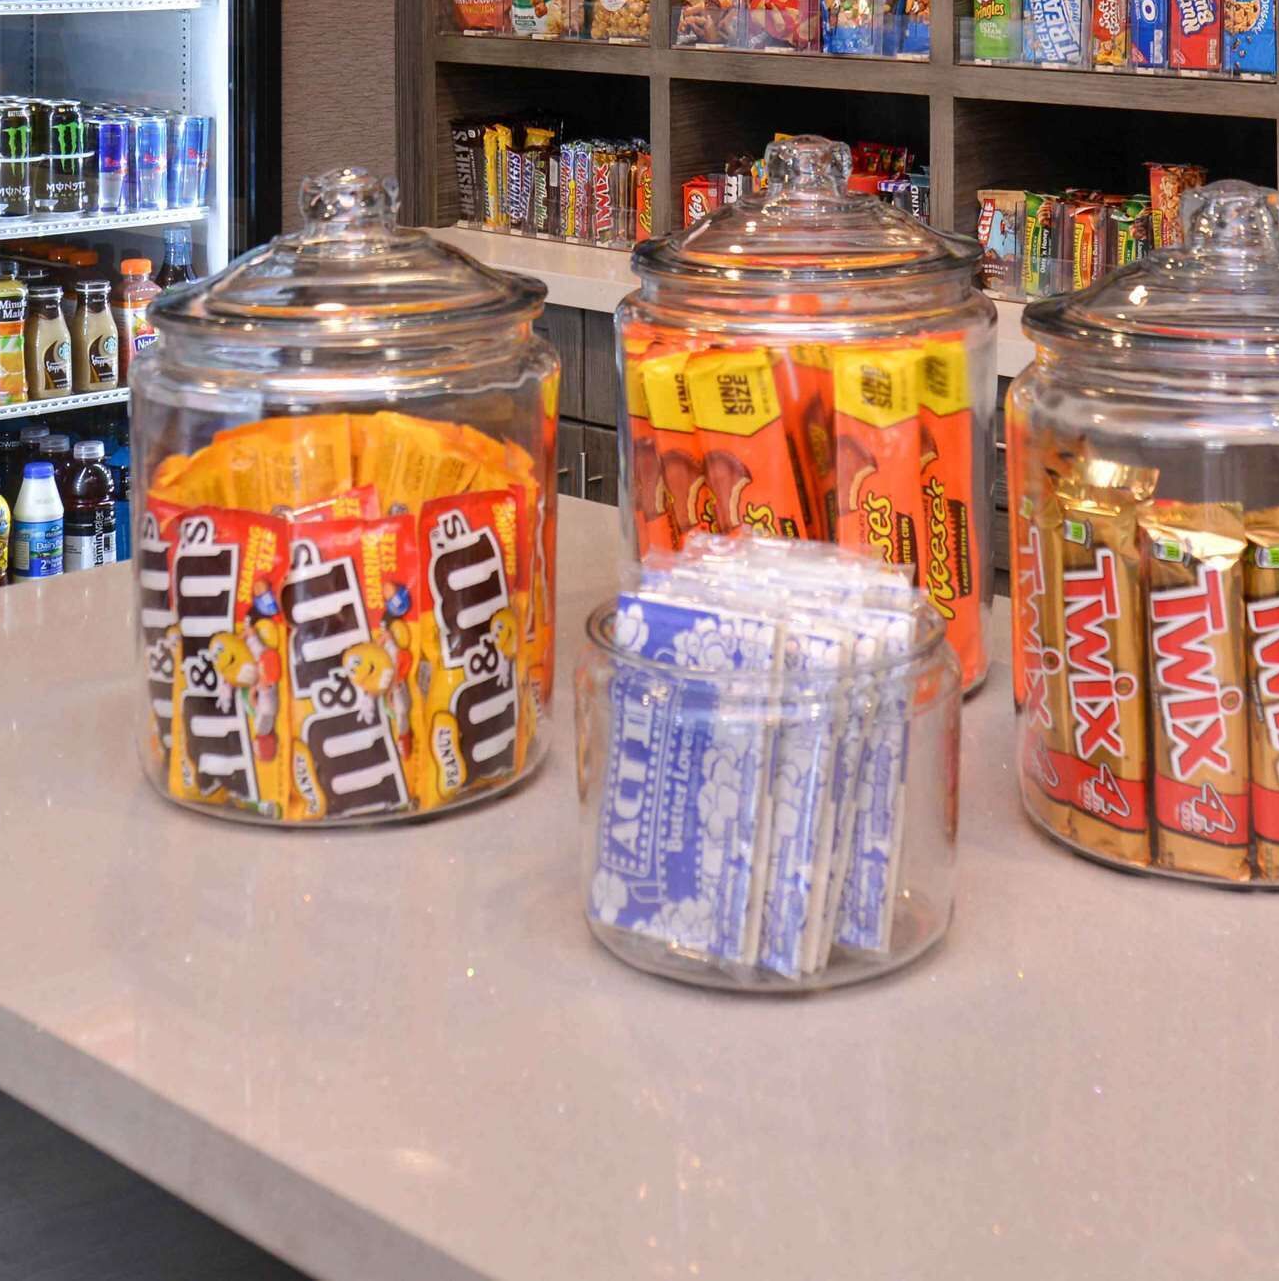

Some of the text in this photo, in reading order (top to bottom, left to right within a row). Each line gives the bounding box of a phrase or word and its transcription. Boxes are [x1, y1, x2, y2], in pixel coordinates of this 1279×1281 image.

[452, 129, 475, 216] HERSHEY'S
[507, 150, 522, 220] SNICKERS
[721, 373, 756, 416] KING SIZE
[860, 365, 894, 410] KING SIZE
[238, 525, 277, 603] SHARING SIZE
[360, 531, 398, 610] SHARING SIZE
[926, 477, 957, 620] Reese's
